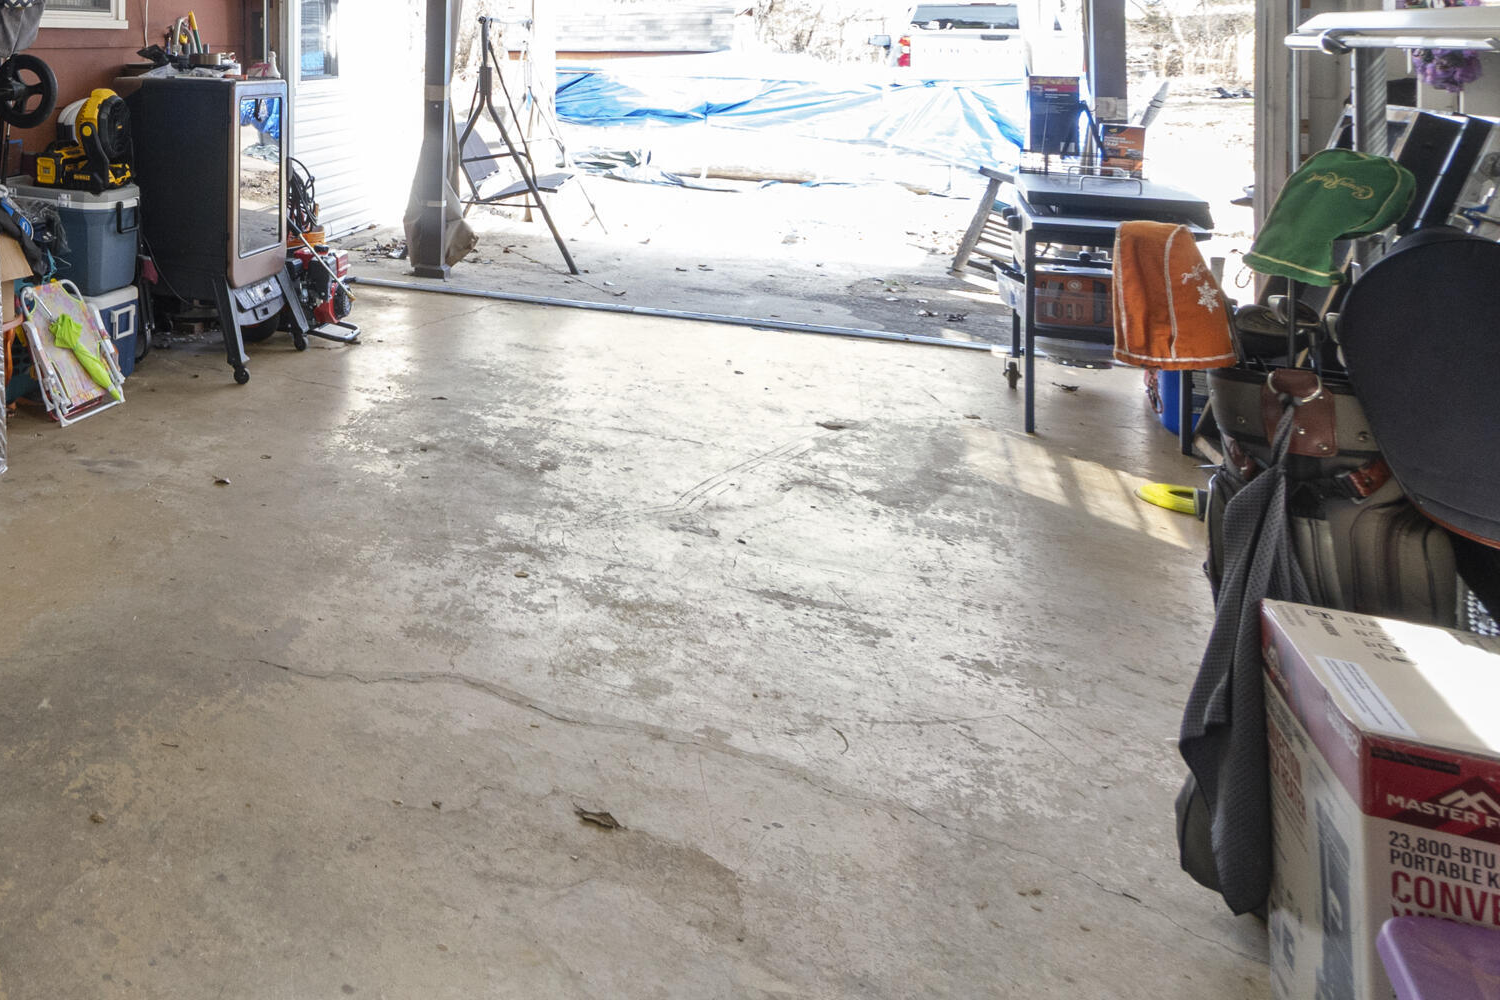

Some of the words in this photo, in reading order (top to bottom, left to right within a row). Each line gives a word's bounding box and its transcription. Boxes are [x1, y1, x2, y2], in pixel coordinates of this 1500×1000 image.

[1387, 794, 1479, 825] MASTER
[1389, 831, 1495, 869] 23,800-BTU
[1390, 849, 1482, 884] PORTABLE
